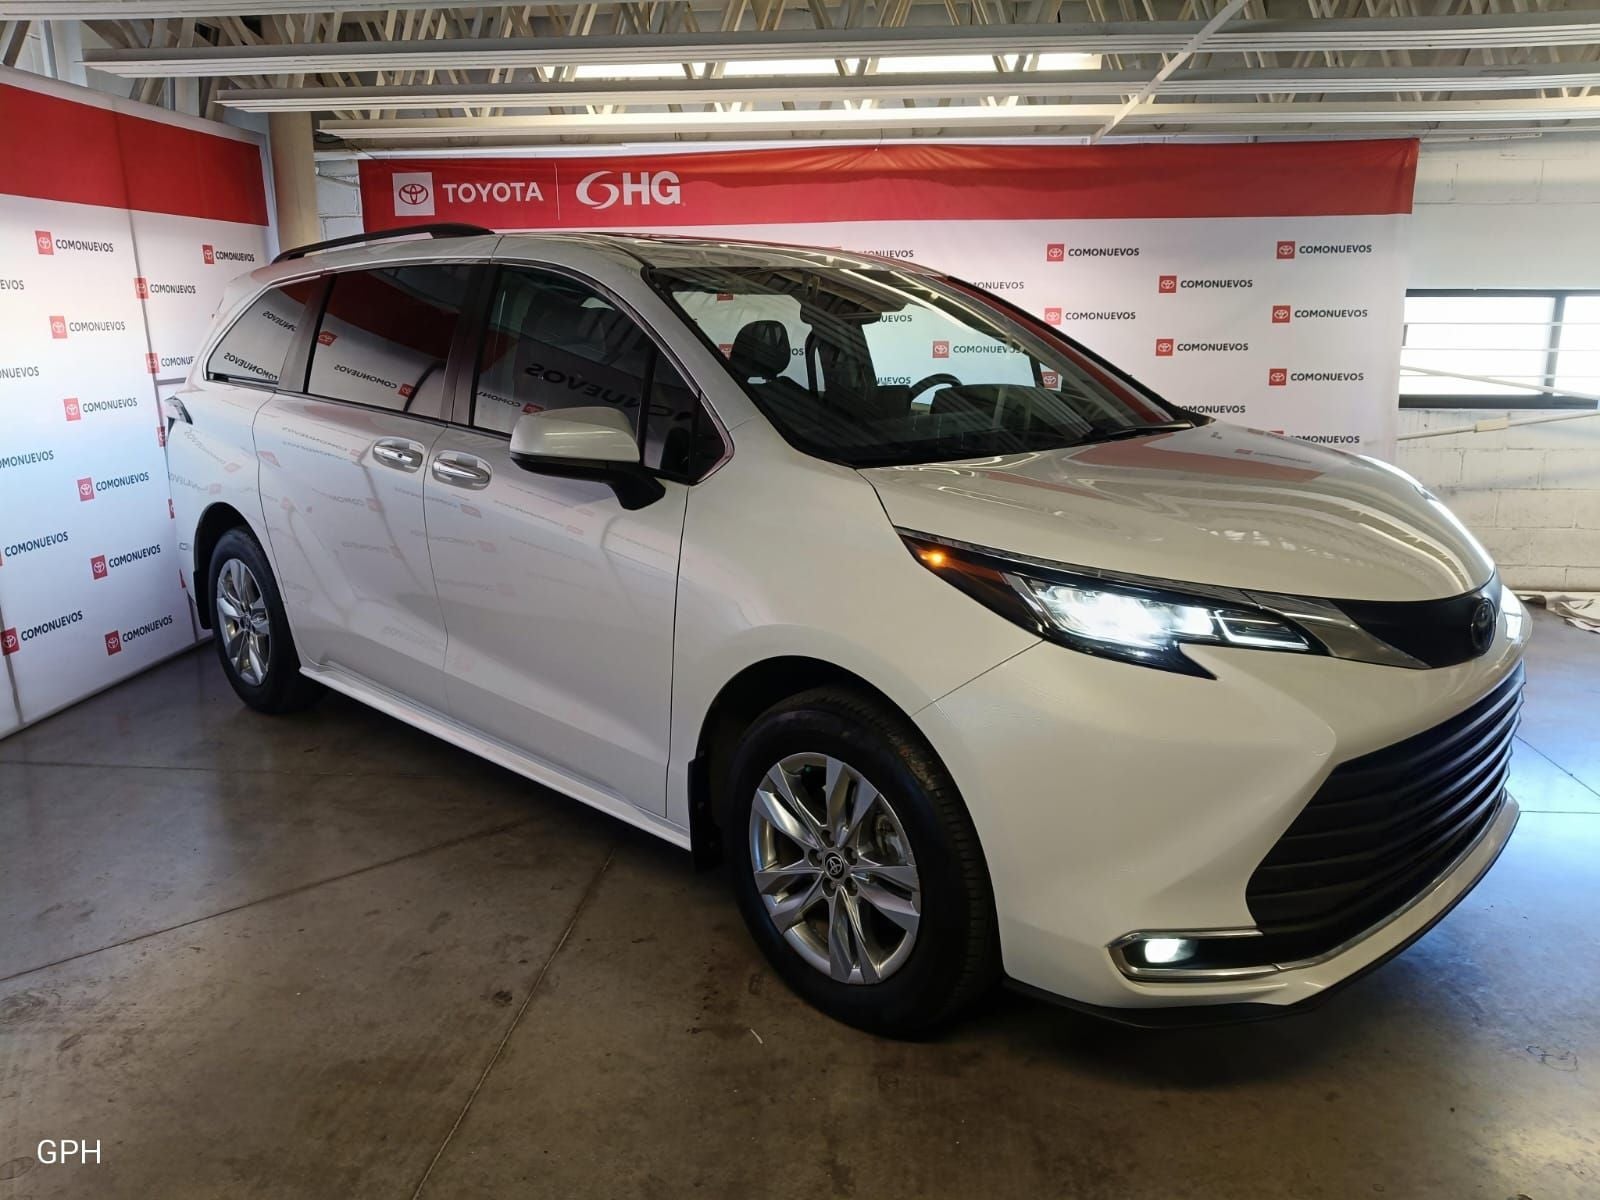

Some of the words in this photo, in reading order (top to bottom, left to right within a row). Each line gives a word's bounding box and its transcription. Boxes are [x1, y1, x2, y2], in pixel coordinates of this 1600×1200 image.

[442, 182, 544, 203] TOYOTA
[55, 239, 114, 252] COMONUEVOS
[1299, 244, 1372, 254] COMONUEVOS
[215, 251, 255, 262] COMONUEVOS
[1068, 248, 1140, 257] COMONUEVOS
[0, 279, 25, 290] EVOS
[150, 284, 196, 294] COMONUEVOS
[974, 281, 1024, 289] ONUEVOS
[1180, 279, 1253, 288] COMONUEVOS
[1065, 311, 1136, 320] COMONUEVOS
[1294, 309, 1368, 318] COMONUEVOS
[69, 321, 126, 332] COMONUEVOS
[1176, 342, 1249, 351] COMONUEVOS
[0, 366, 40, 378] NUEVOS
[1290, 371, 1364, 381] COMONUEVOS
[83, 398, 138, 412] COMONUEVOS
[96, 472, 149, 492] COMONUEVOS
[5, 531, 69, 558] COMONUEVOS
[108, 544, 161, 568] COMONUEVOS
[21, 611, 83, 643] COMONUEVOS
[122, 614, 173, 643] COMONUEVOS
